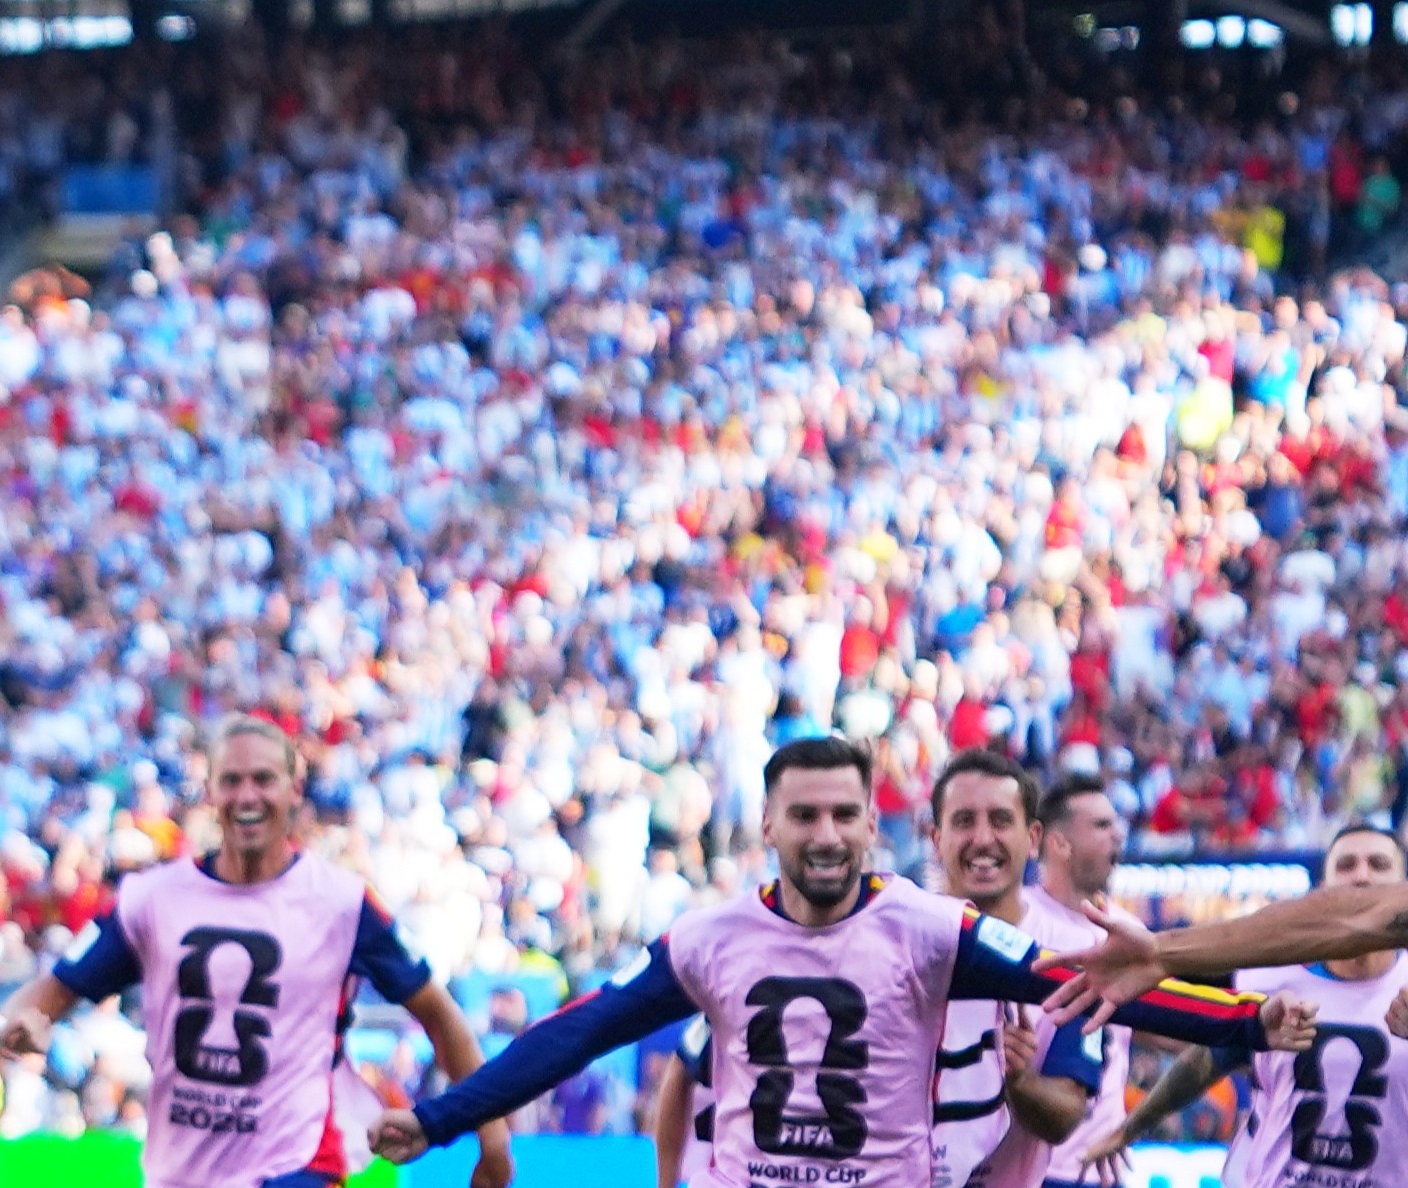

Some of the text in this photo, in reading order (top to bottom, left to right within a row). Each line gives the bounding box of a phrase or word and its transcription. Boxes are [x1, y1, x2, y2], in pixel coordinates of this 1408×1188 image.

[170, 1103, 258, 1134] 2026
[780, 1125, 834, 1147] FIFA
[748, 1161, 867, 1184] WORLD CUP
